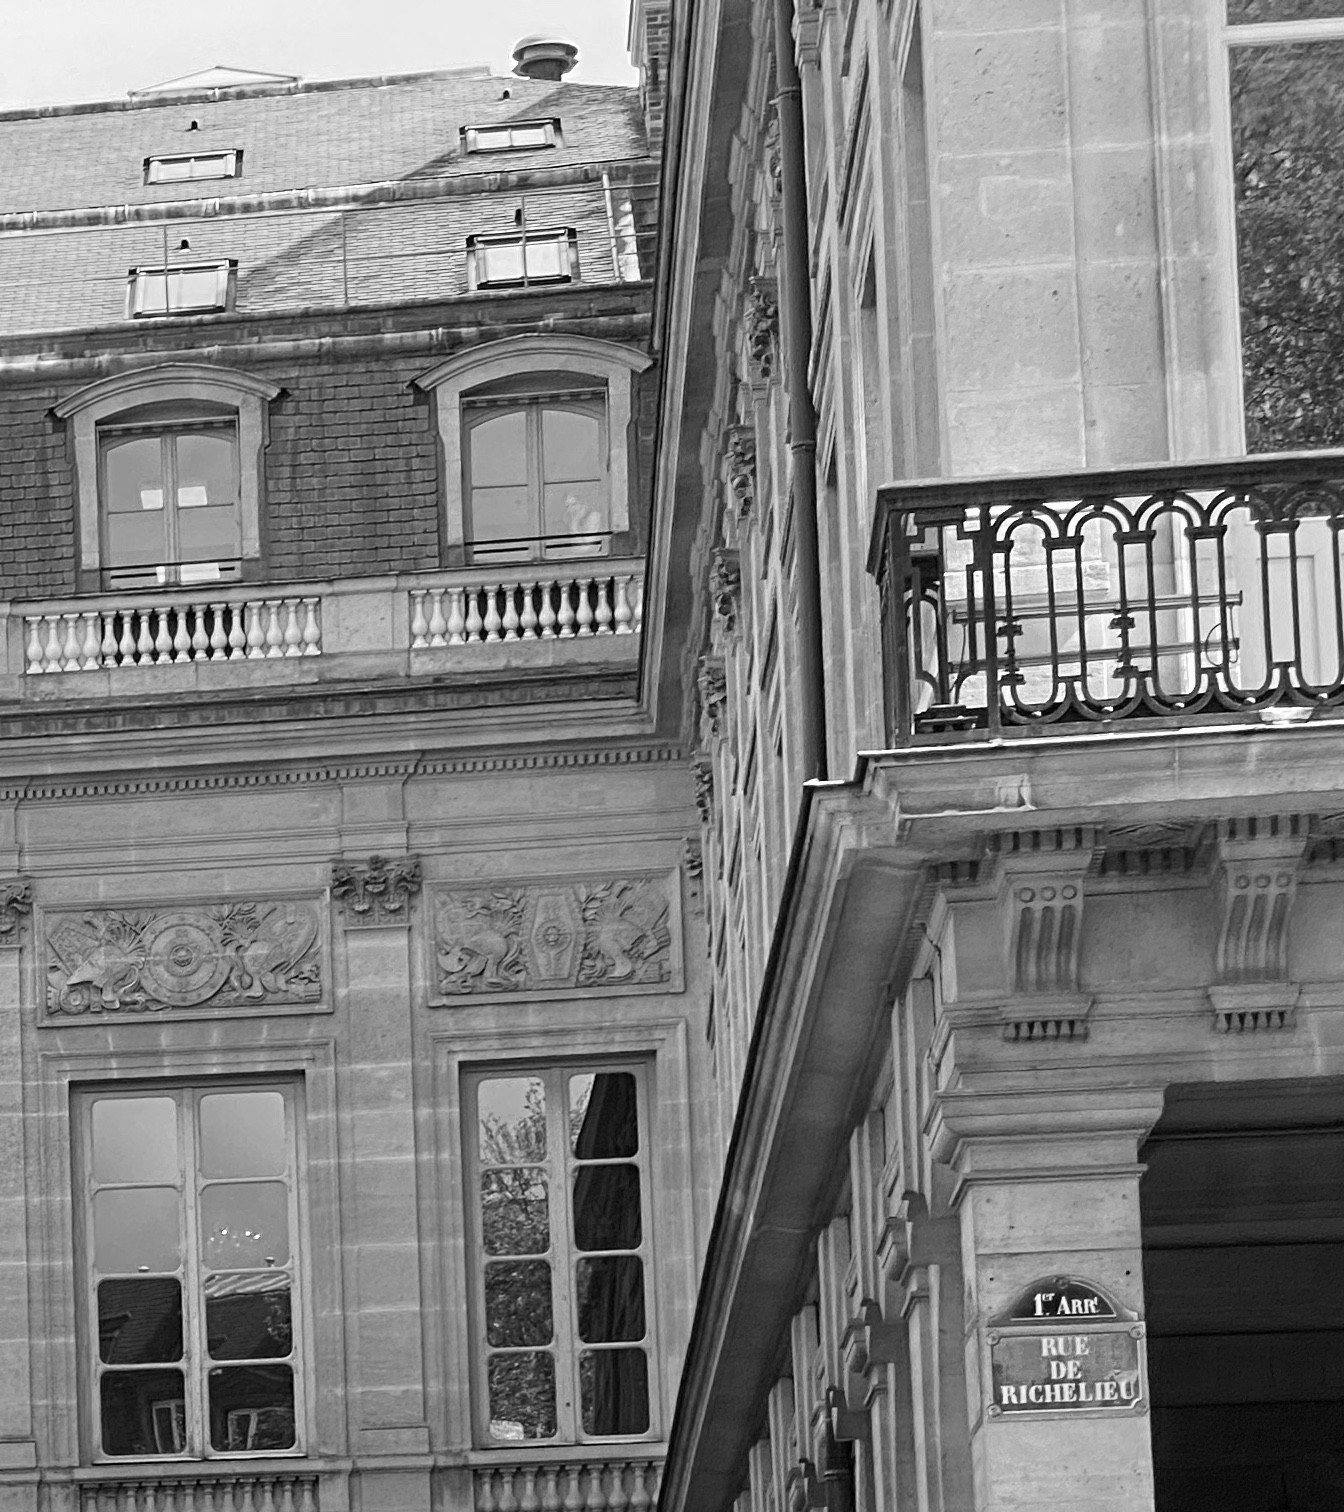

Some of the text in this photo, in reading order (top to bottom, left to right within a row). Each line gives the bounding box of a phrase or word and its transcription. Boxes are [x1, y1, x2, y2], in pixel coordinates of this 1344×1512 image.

[1041, 1336, 1089, 1357] RUE
[1050, 1360, 1082, 1380] DE
[1000, 1381, 1135, 1405] RICHELIEU
